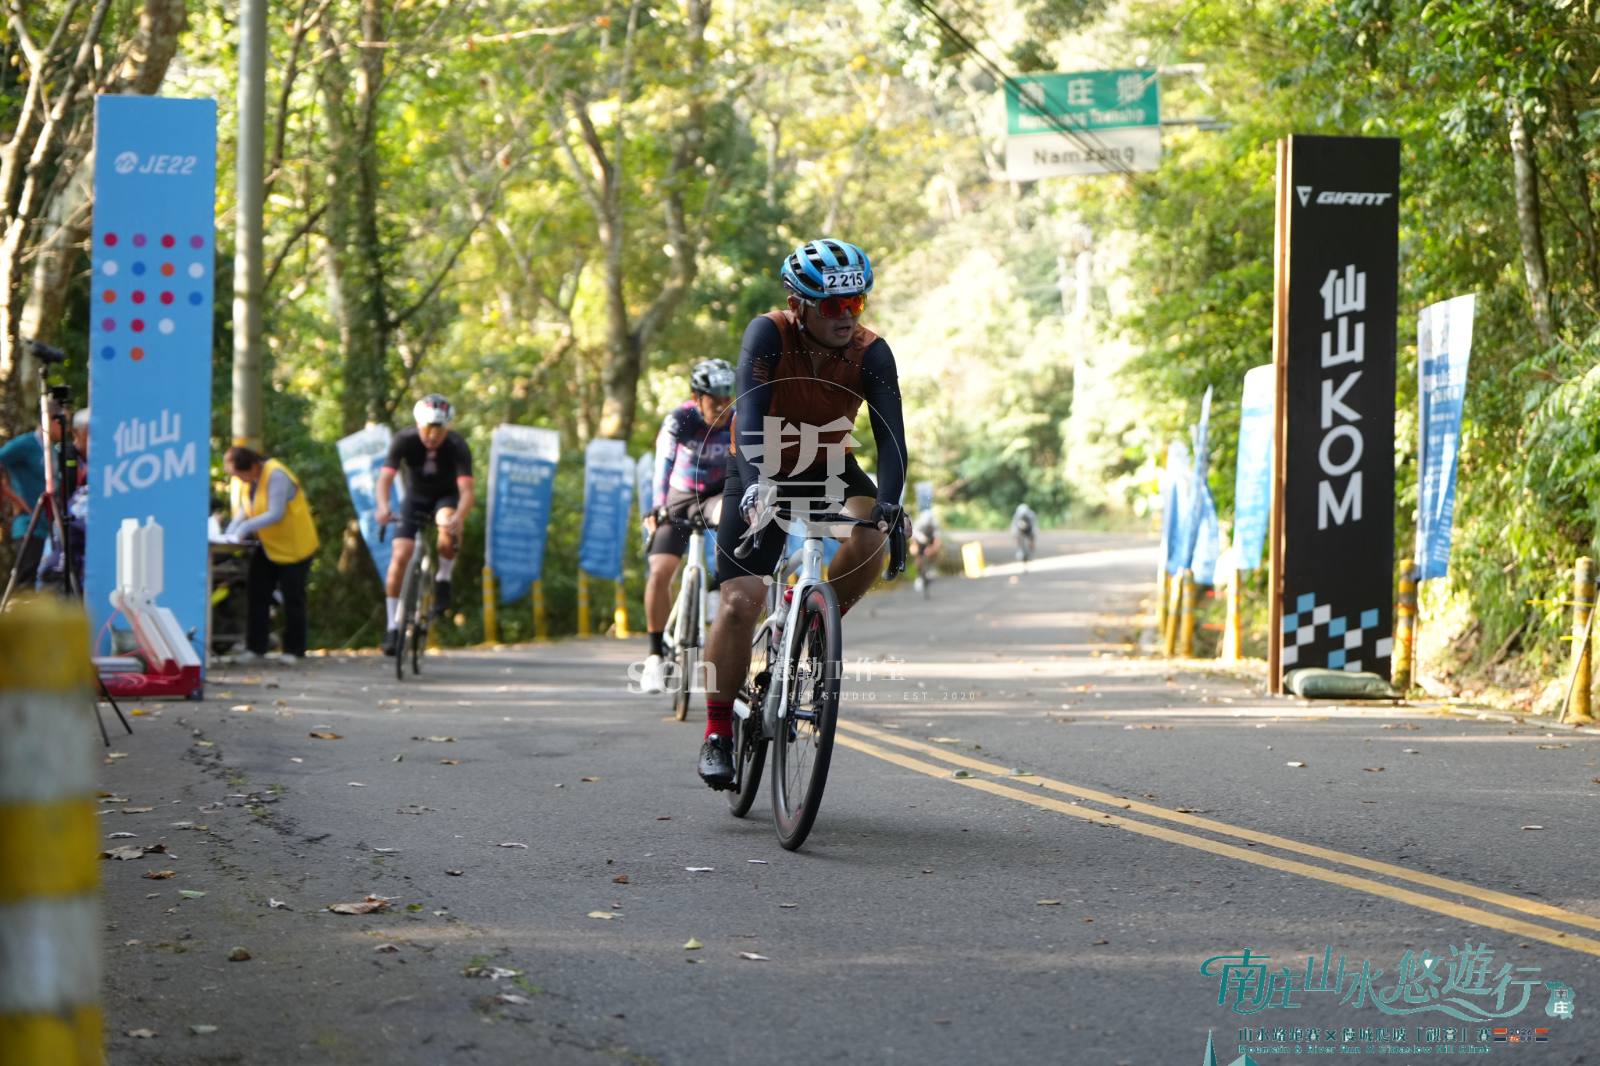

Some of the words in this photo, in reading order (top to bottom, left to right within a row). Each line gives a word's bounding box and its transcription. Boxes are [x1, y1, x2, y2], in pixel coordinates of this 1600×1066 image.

[139, 155, 197, 174] JE22
[1317, 192, 1393, 206] GIANT
[113, 408, 181, 457] 仙山
[102, 441, 197, 498] KOM
